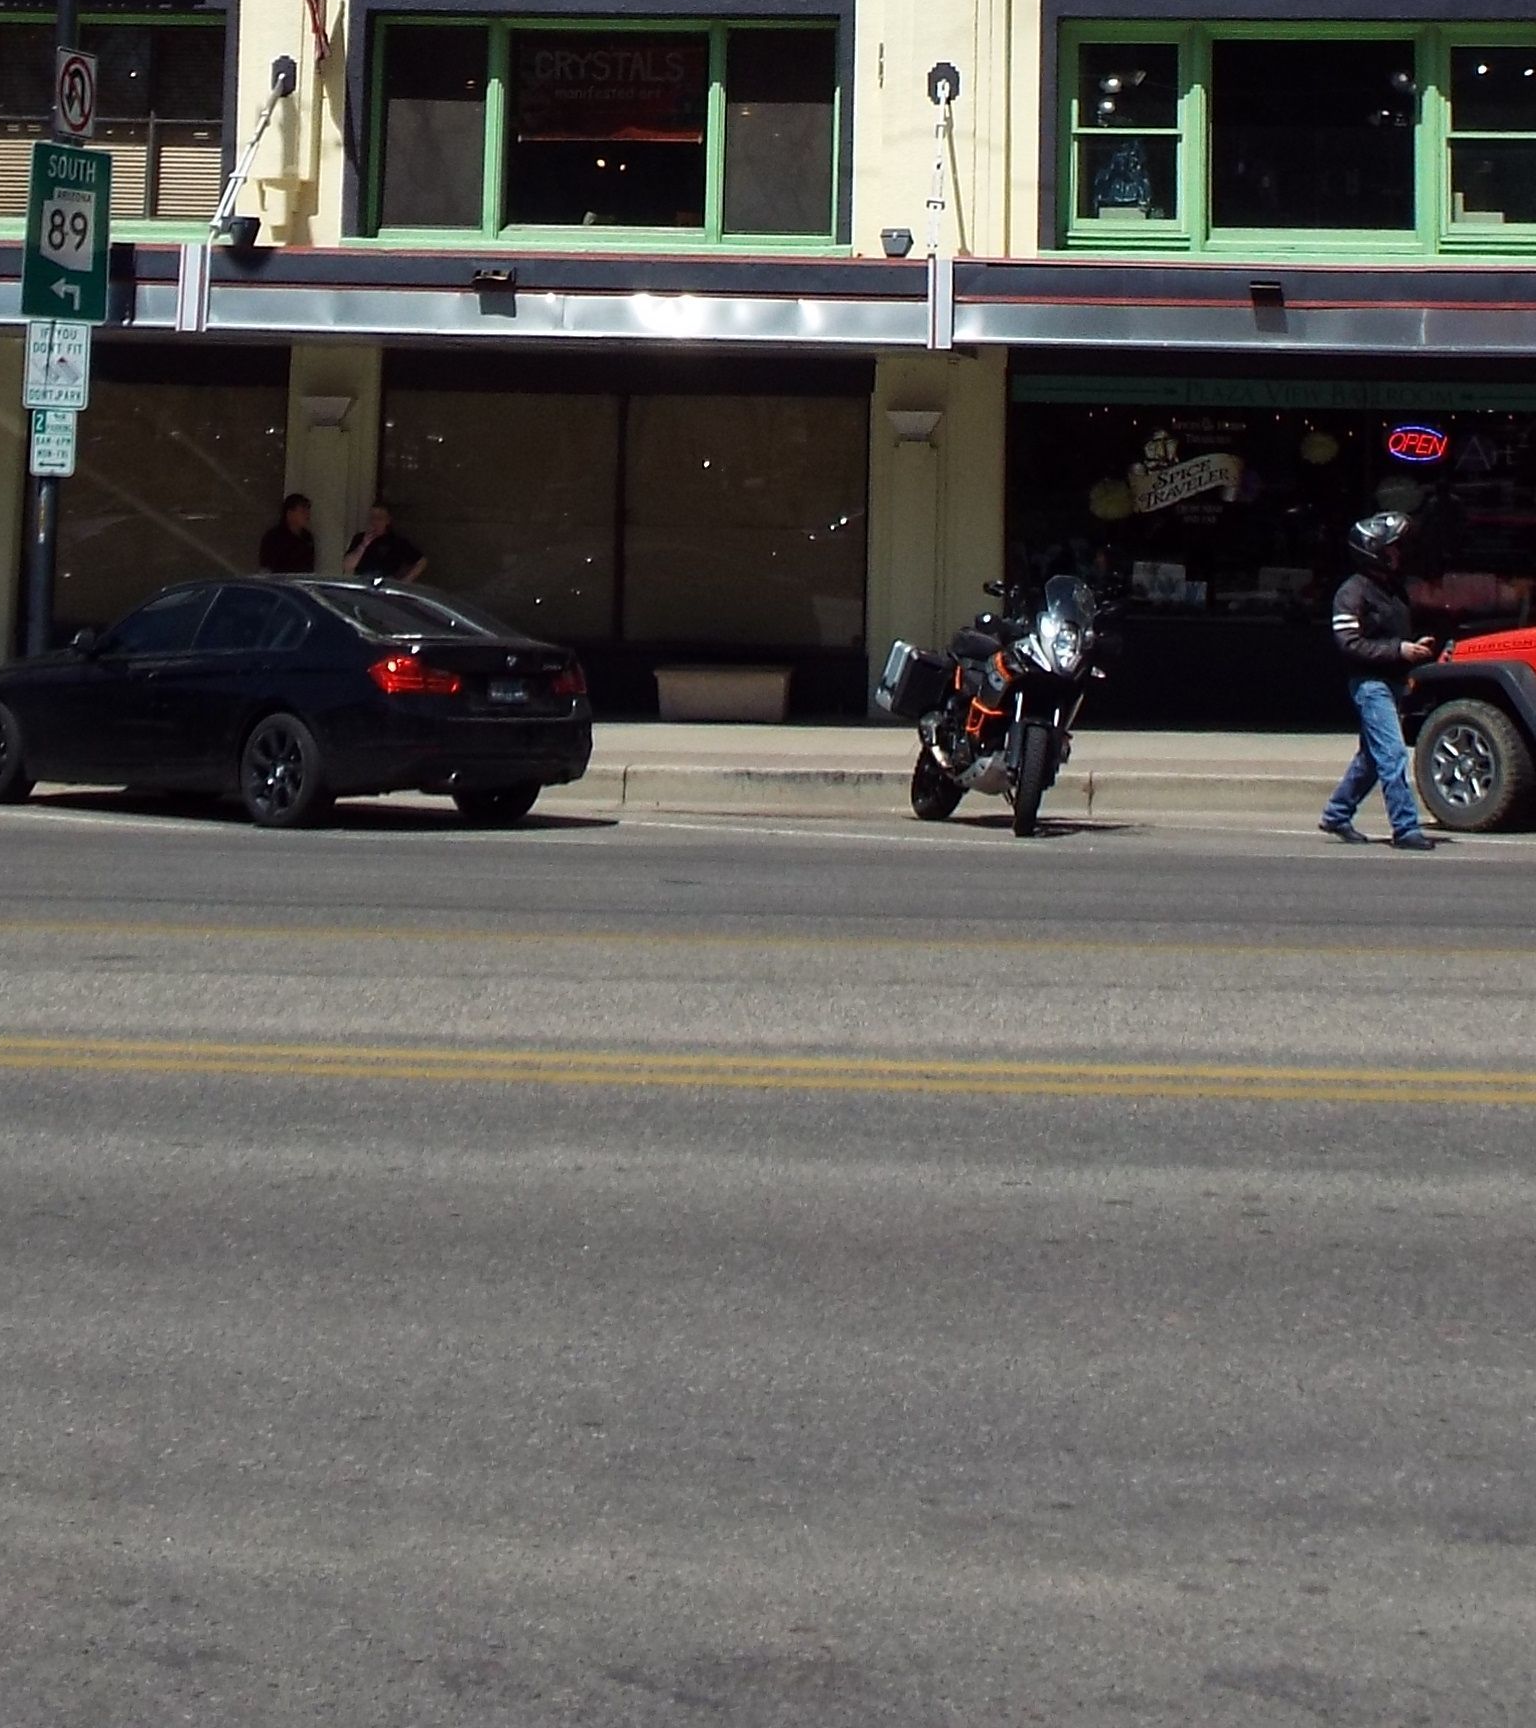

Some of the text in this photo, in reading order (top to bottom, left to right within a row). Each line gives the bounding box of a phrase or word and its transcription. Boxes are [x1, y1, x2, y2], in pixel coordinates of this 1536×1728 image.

[534, 50, 685, 83] CRYSTALS
[47, 154, 97, 184] SOUTH
[56, 190, 92, 203] ARIZONA
[48, 209, 88, 252] 89
[56, 328, 77, 340] YOU
[67, 343, 82, 355] FIT
[1184, 380, 1257, 404] PLAZA
[35, 414, 44, 431] 2
[1388, 432, 1449, 456] OPEN
[1153, 459, 1211, 489] SPICE
[1138, 468, 1229, 510] TRAVELER
[1468, 639, 1534, 653] RUBICON
